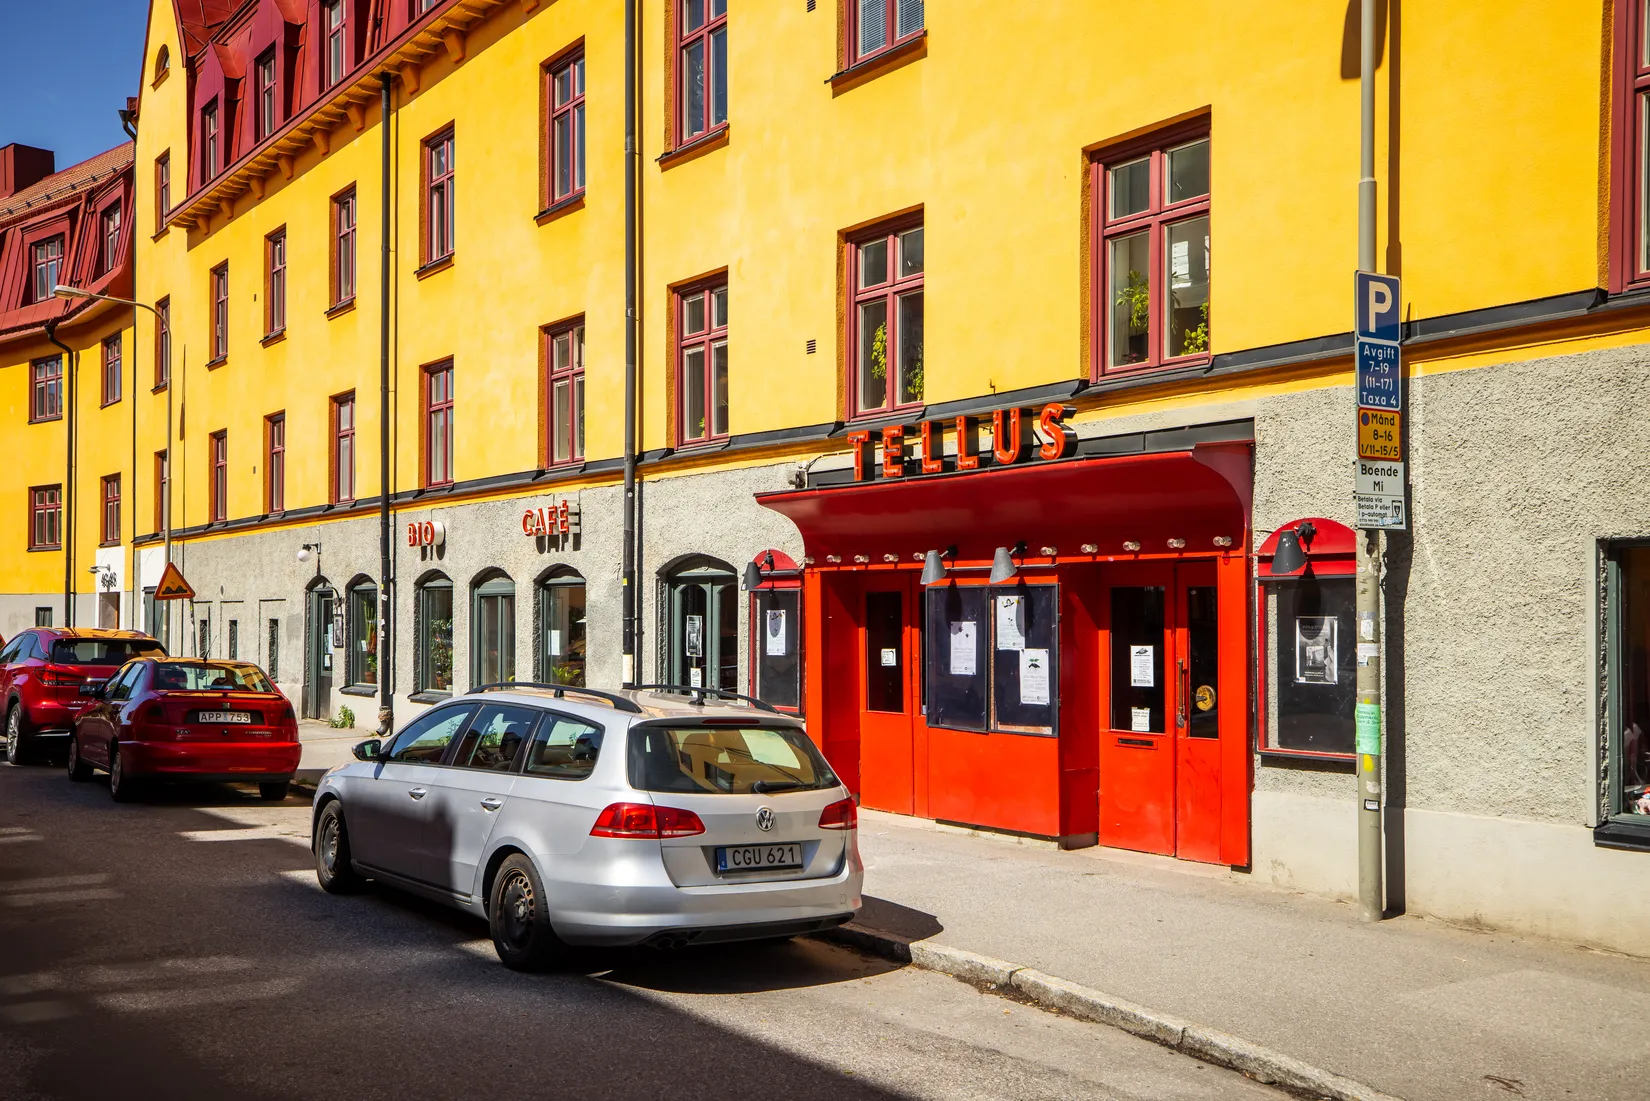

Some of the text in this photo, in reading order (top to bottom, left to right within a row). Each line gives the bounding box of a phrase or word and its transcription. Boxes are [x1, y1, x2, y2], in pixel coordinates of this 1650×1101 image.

[1369, 281, 1392, 332] P
[1363, 345, 1395, 360] Avgift
[1369, 361, 1389, 374] 7-19
[1365, 375, 1393, 391] (11-17)
[1362, 392, 1397, 406] Taxa 4
[1371, 413, 1395, 426] Månd
[848, 403, 1066, 481] TELLUS
[1373, 429, 1393, 441] 8-16
[1361, 444, 1399, 457] 1/11-15/5
[1361, 464, 1399, 477] Boende
[1373, 481, 1384, 492] Mi
[522, 499, 570, 537] CAFÉ
[407, 521, 435, 547] BIO
[200, 713, 250, 722] APP 753
[732, 846, 795, 866] CGU 621
